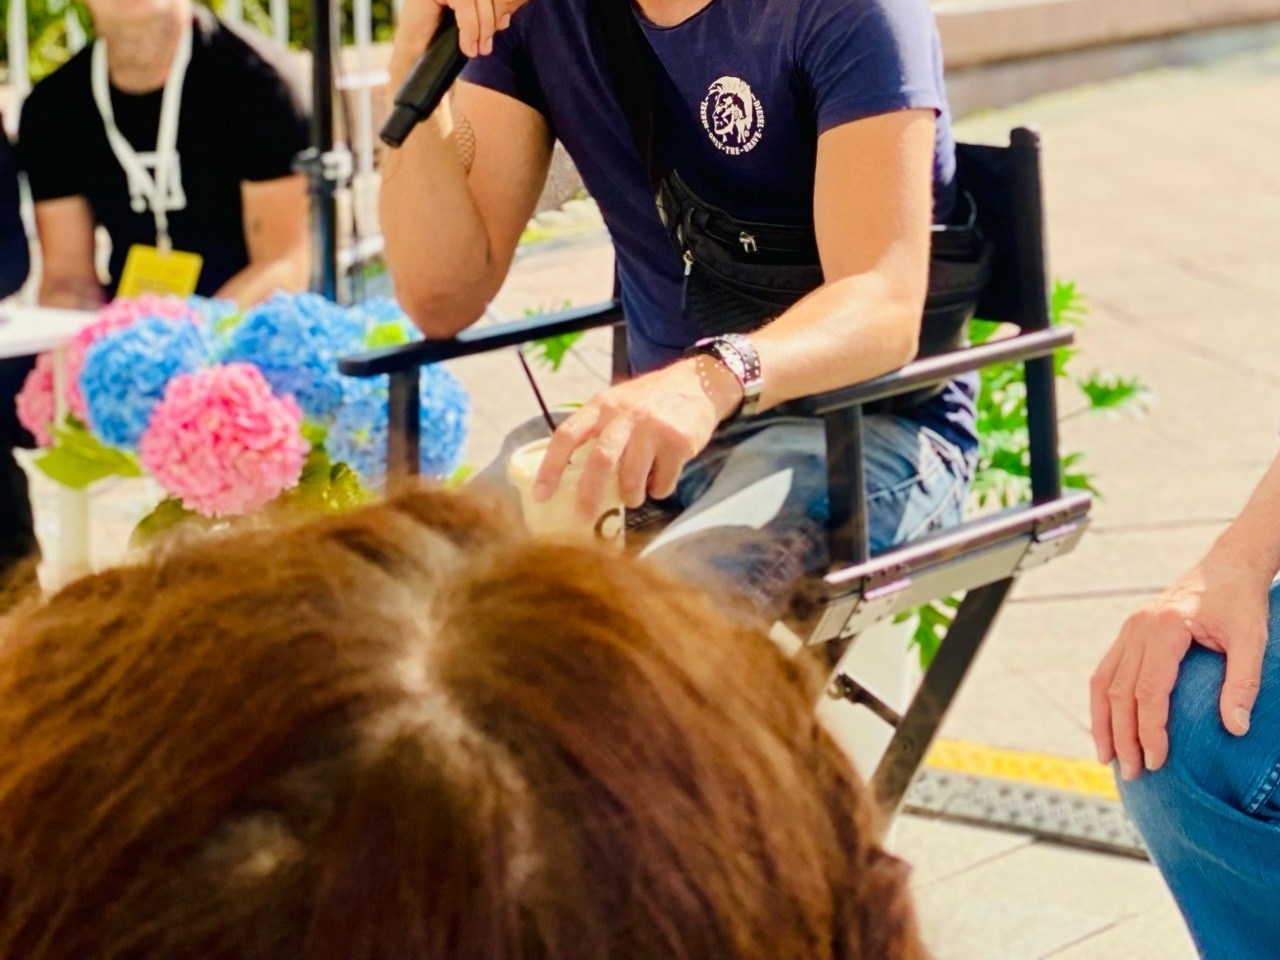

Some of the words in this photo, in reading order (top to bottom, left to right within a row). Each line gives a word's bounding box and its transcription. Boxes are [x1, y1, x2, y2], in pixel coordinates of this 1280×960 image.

[709, 132, 723, 149] ONLY
[725, 146, 740, 155] THE
[743, 131, 762, 152] BRAVE
[753, 100, 765, 128] DIESEL
